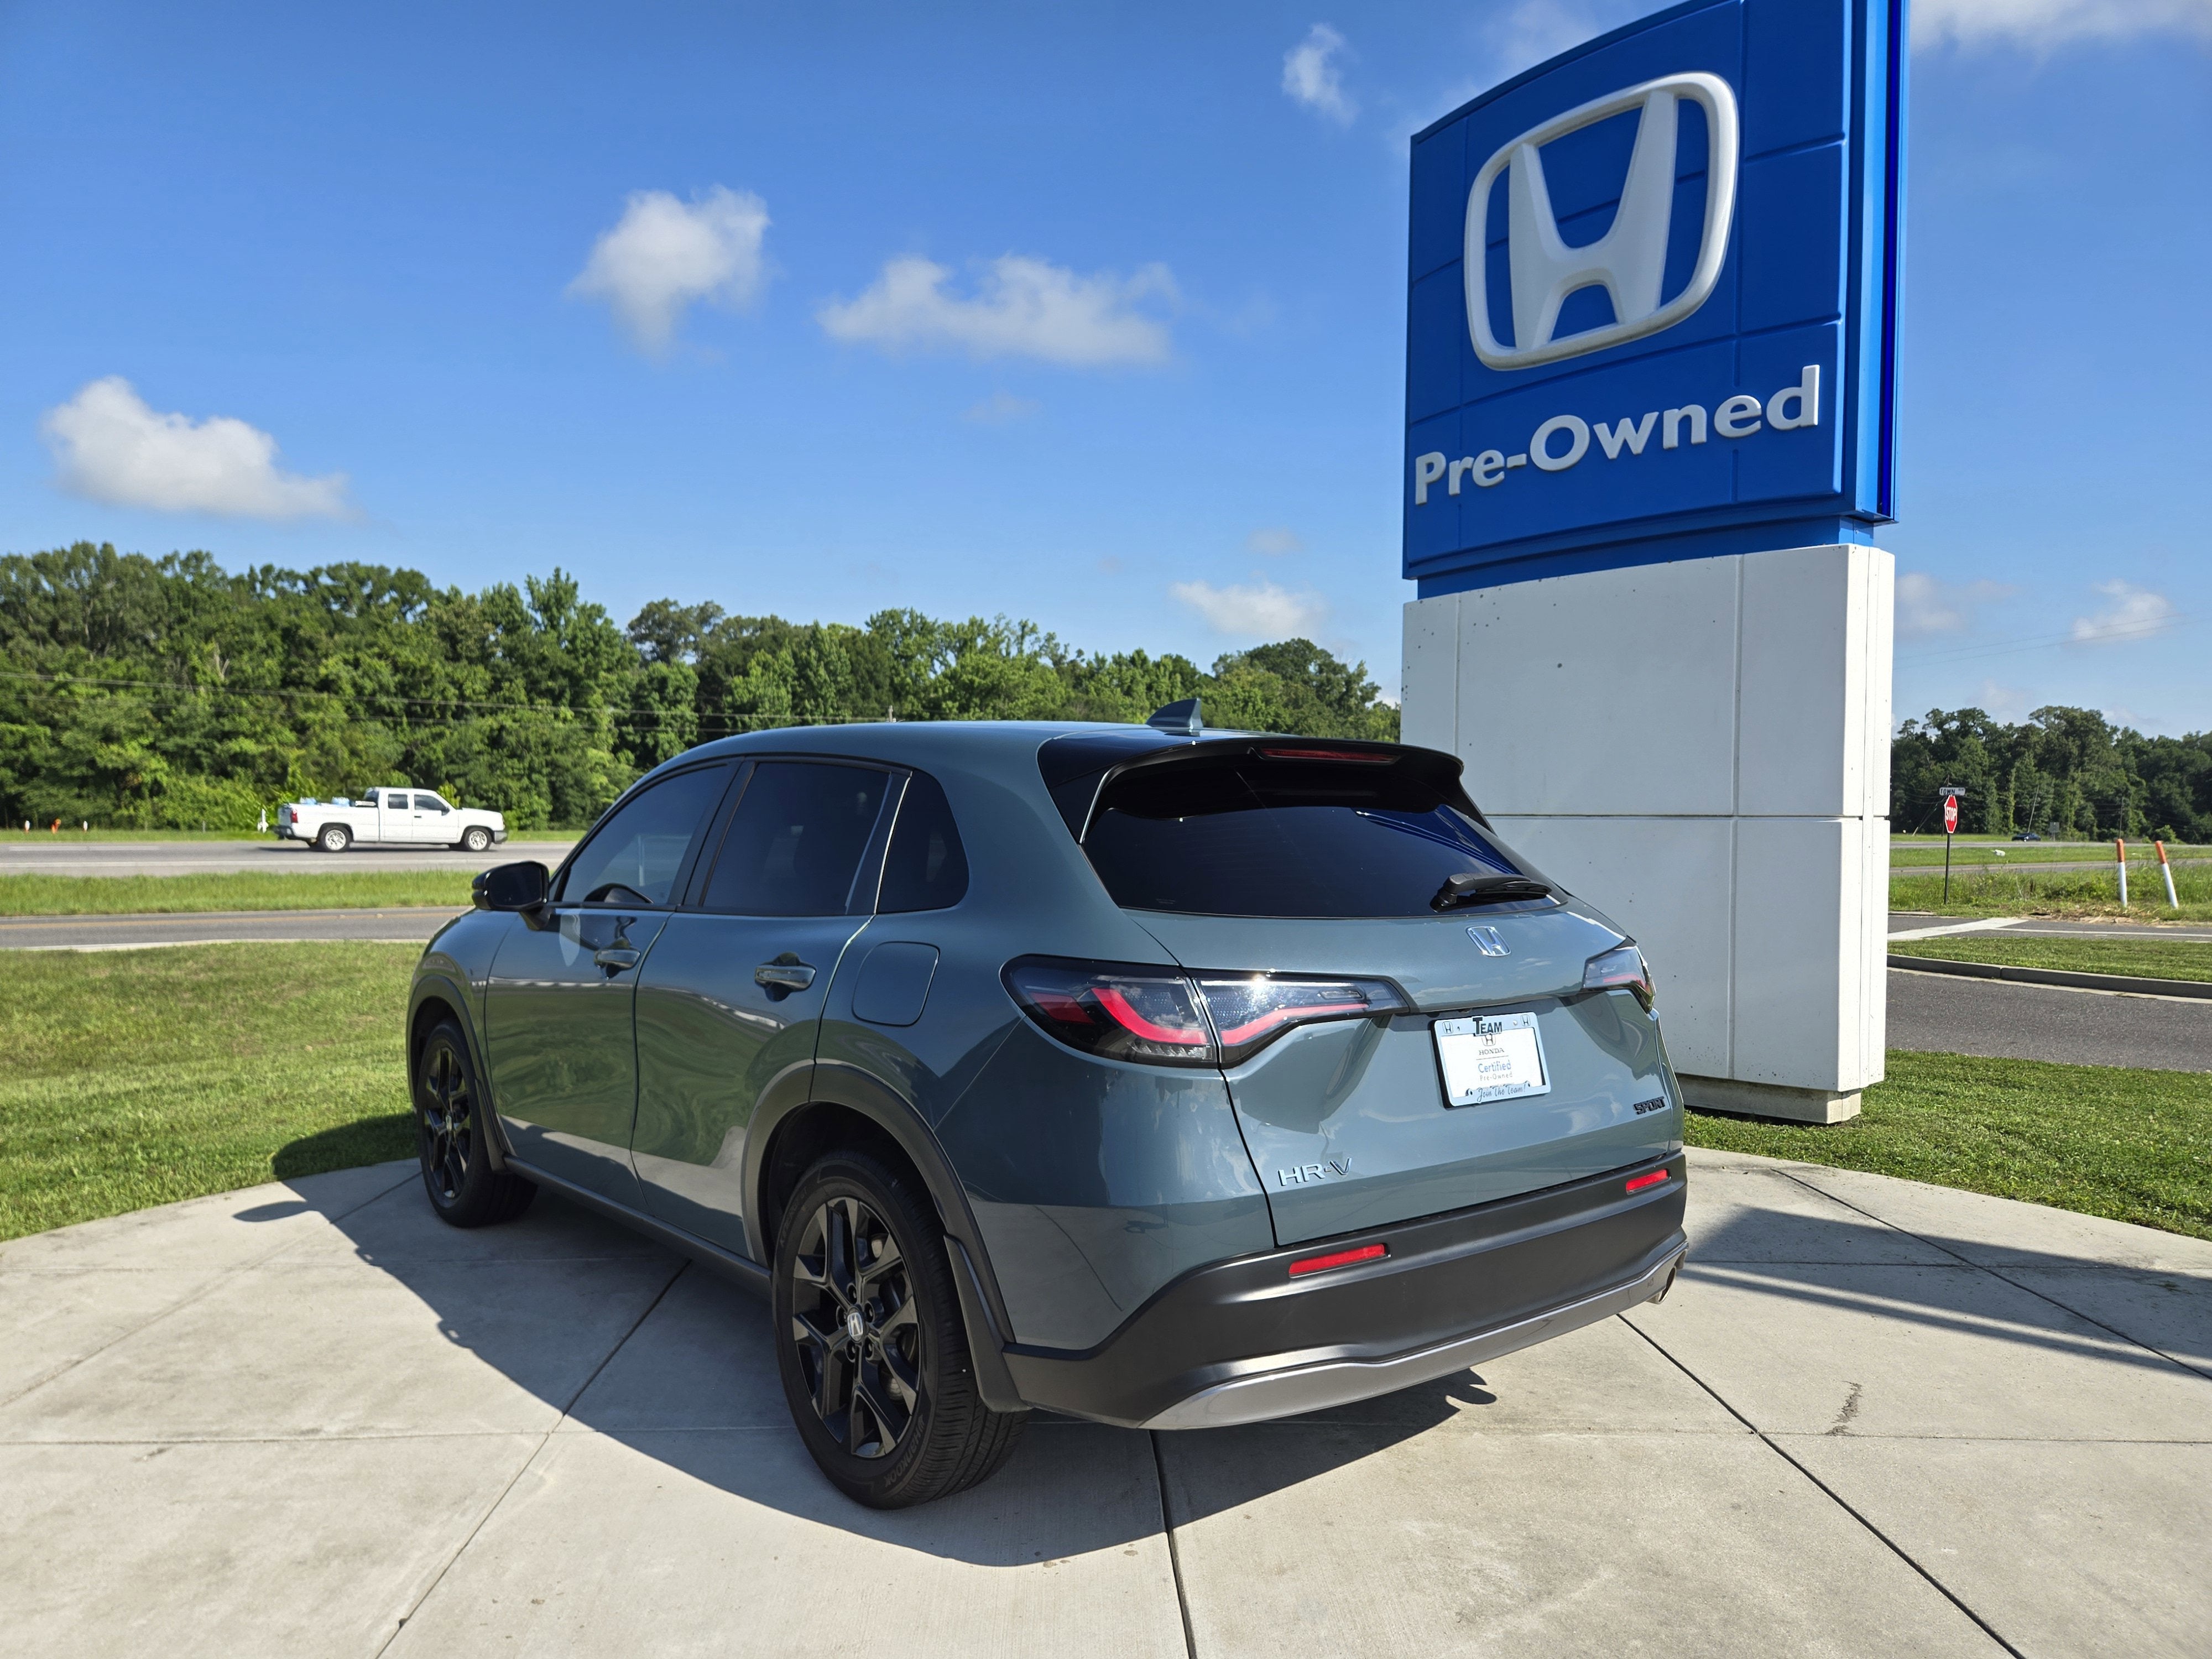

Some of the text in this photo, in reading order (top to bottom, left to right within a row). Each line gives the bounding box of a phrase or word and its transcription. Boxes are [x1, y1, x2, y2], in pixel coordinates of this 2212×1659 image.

[1415, 364, 1820, 505] Pre-Owned
[1945, 806, 1957, 822] STOP
[1472, 1017, 1503, 1035] TEAM
[1478, 1060, 1511, 1073] Certified
[1480, 1071, 1512, 1081] Pre-Owned
[1477, 1087, 1492, 1102] Join
[1633, 1096, 1666, 1115] SPORT
[1277, 1157, 1352, 1186] HR-V
